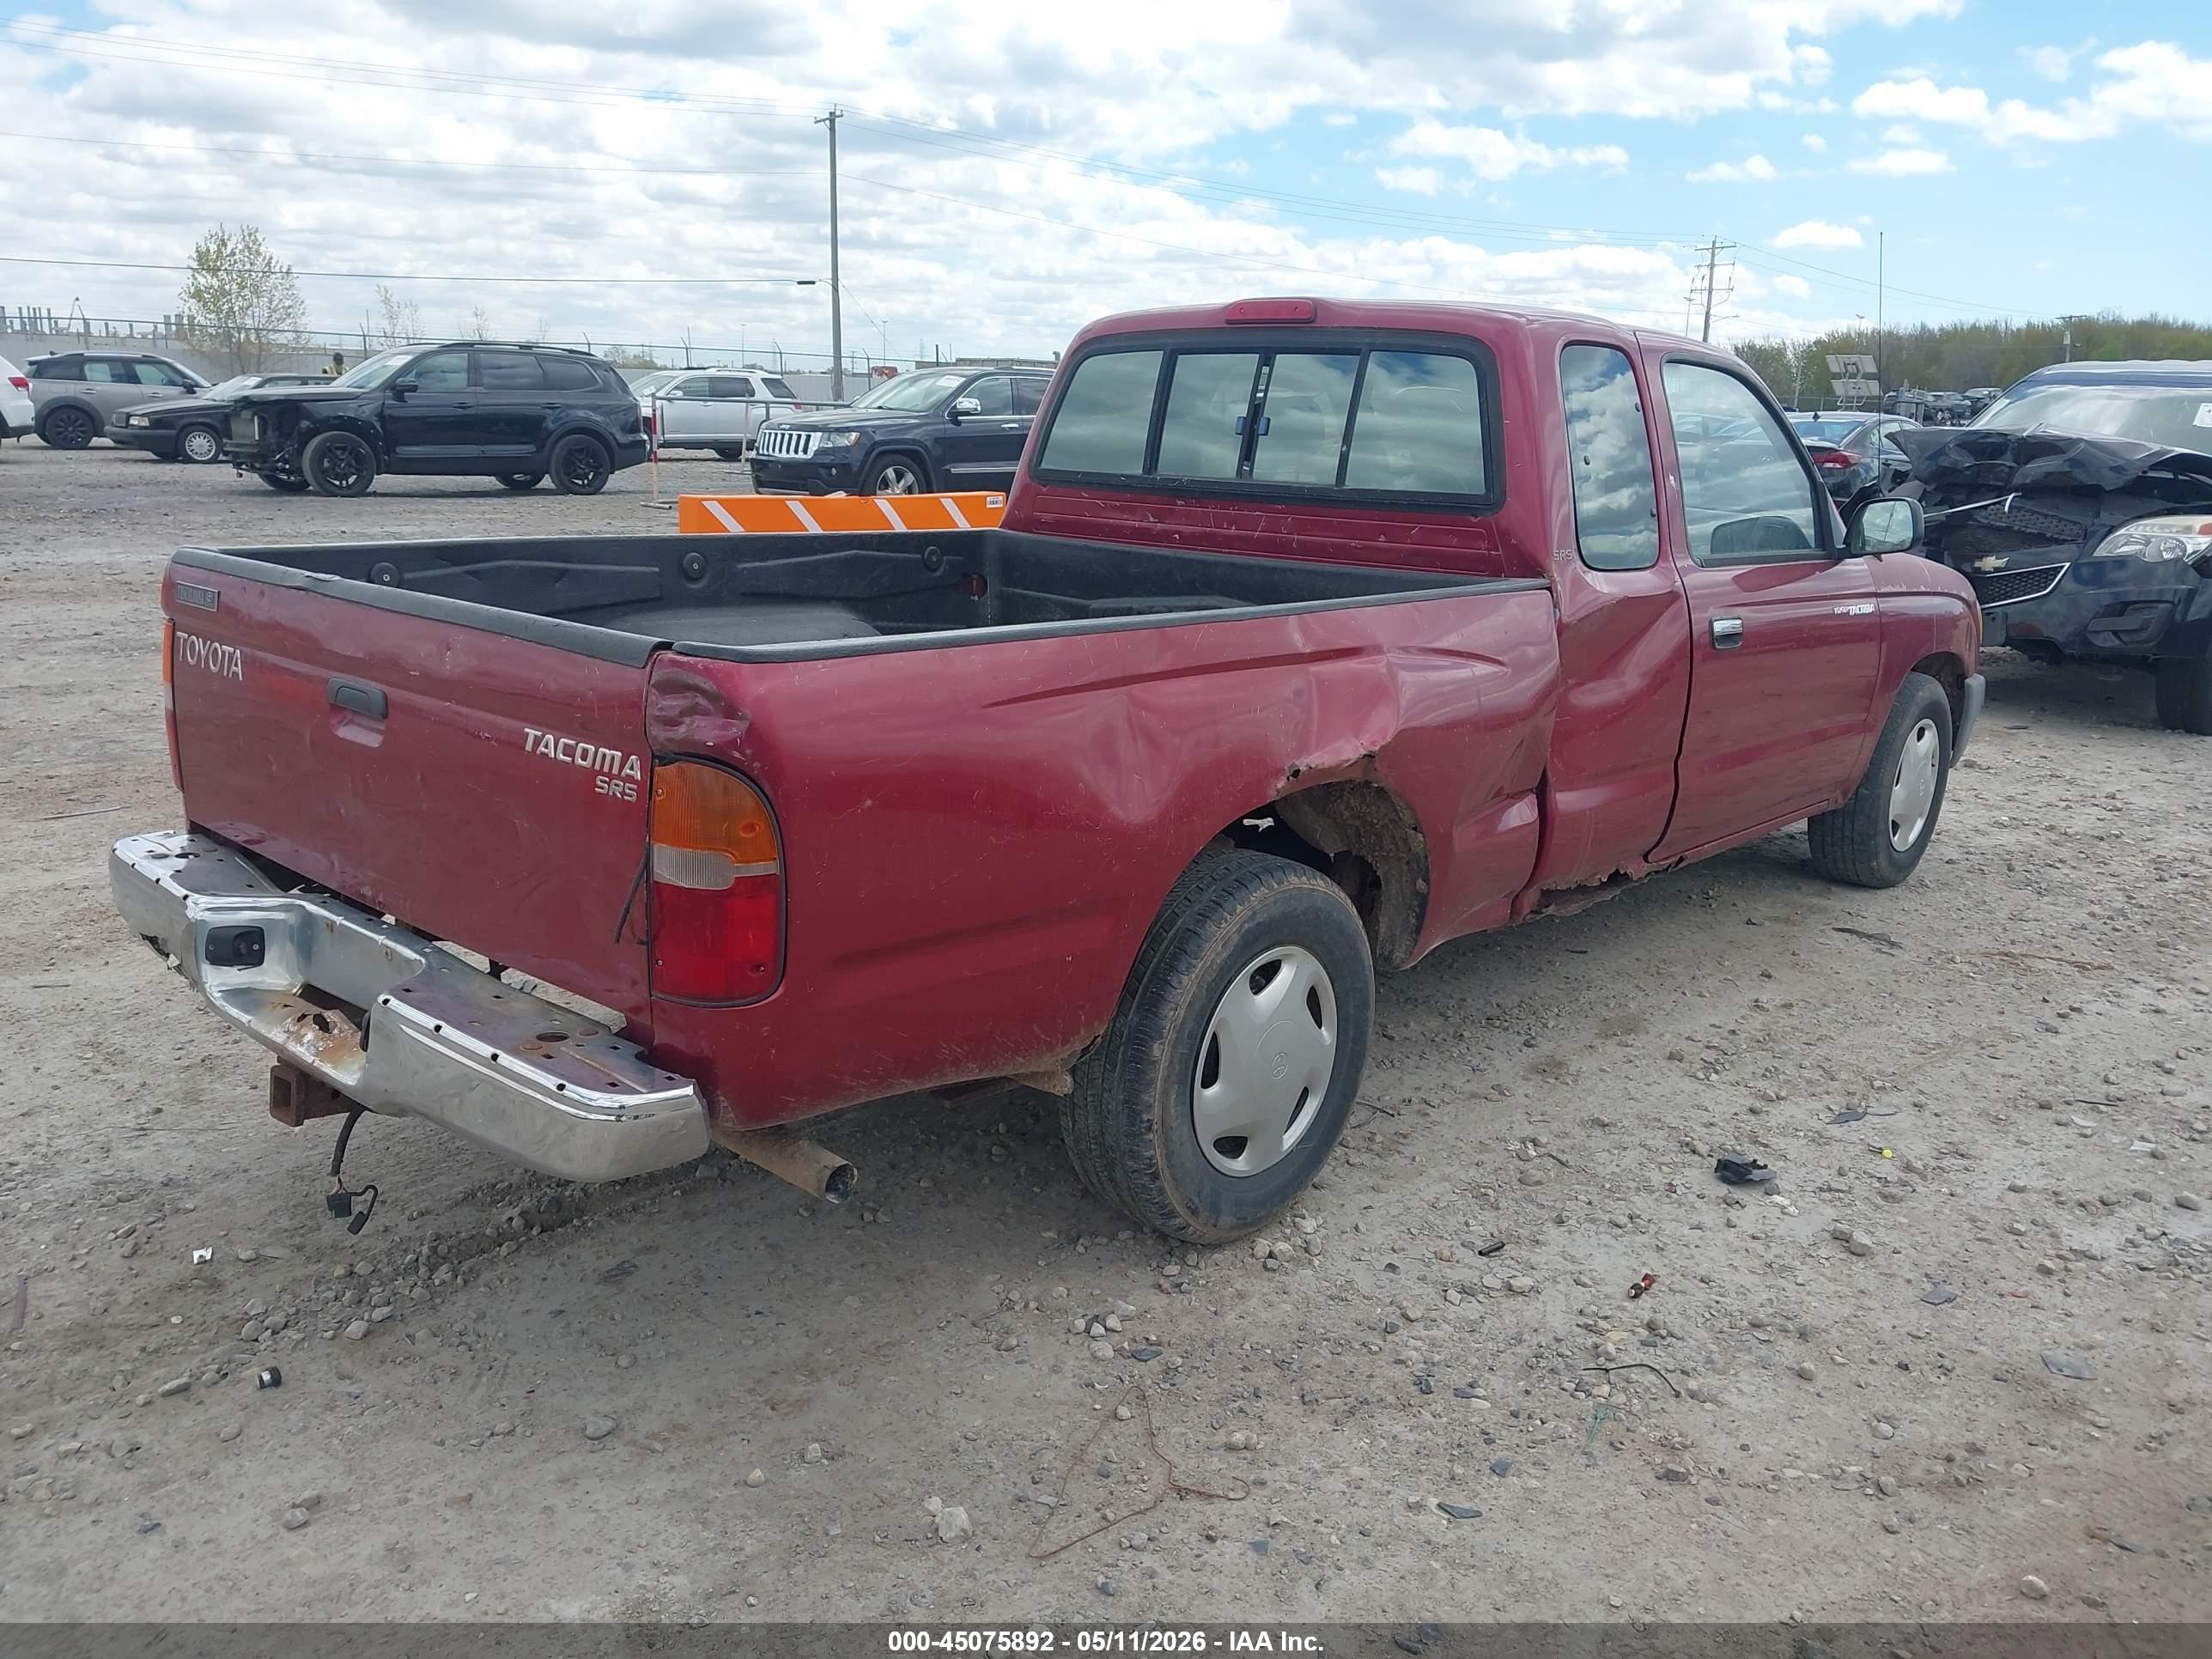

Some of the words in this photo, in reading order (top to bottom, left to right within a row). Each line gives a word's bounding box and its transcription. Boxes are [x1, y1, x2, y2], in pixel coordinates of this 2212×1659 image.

[1553, 550, 1573, 562] SR5
[176, 631, 243, 681] TOYOTA
[523, 727, 641, 781] TACOMA
[594, 775, 639, 803] SR5
